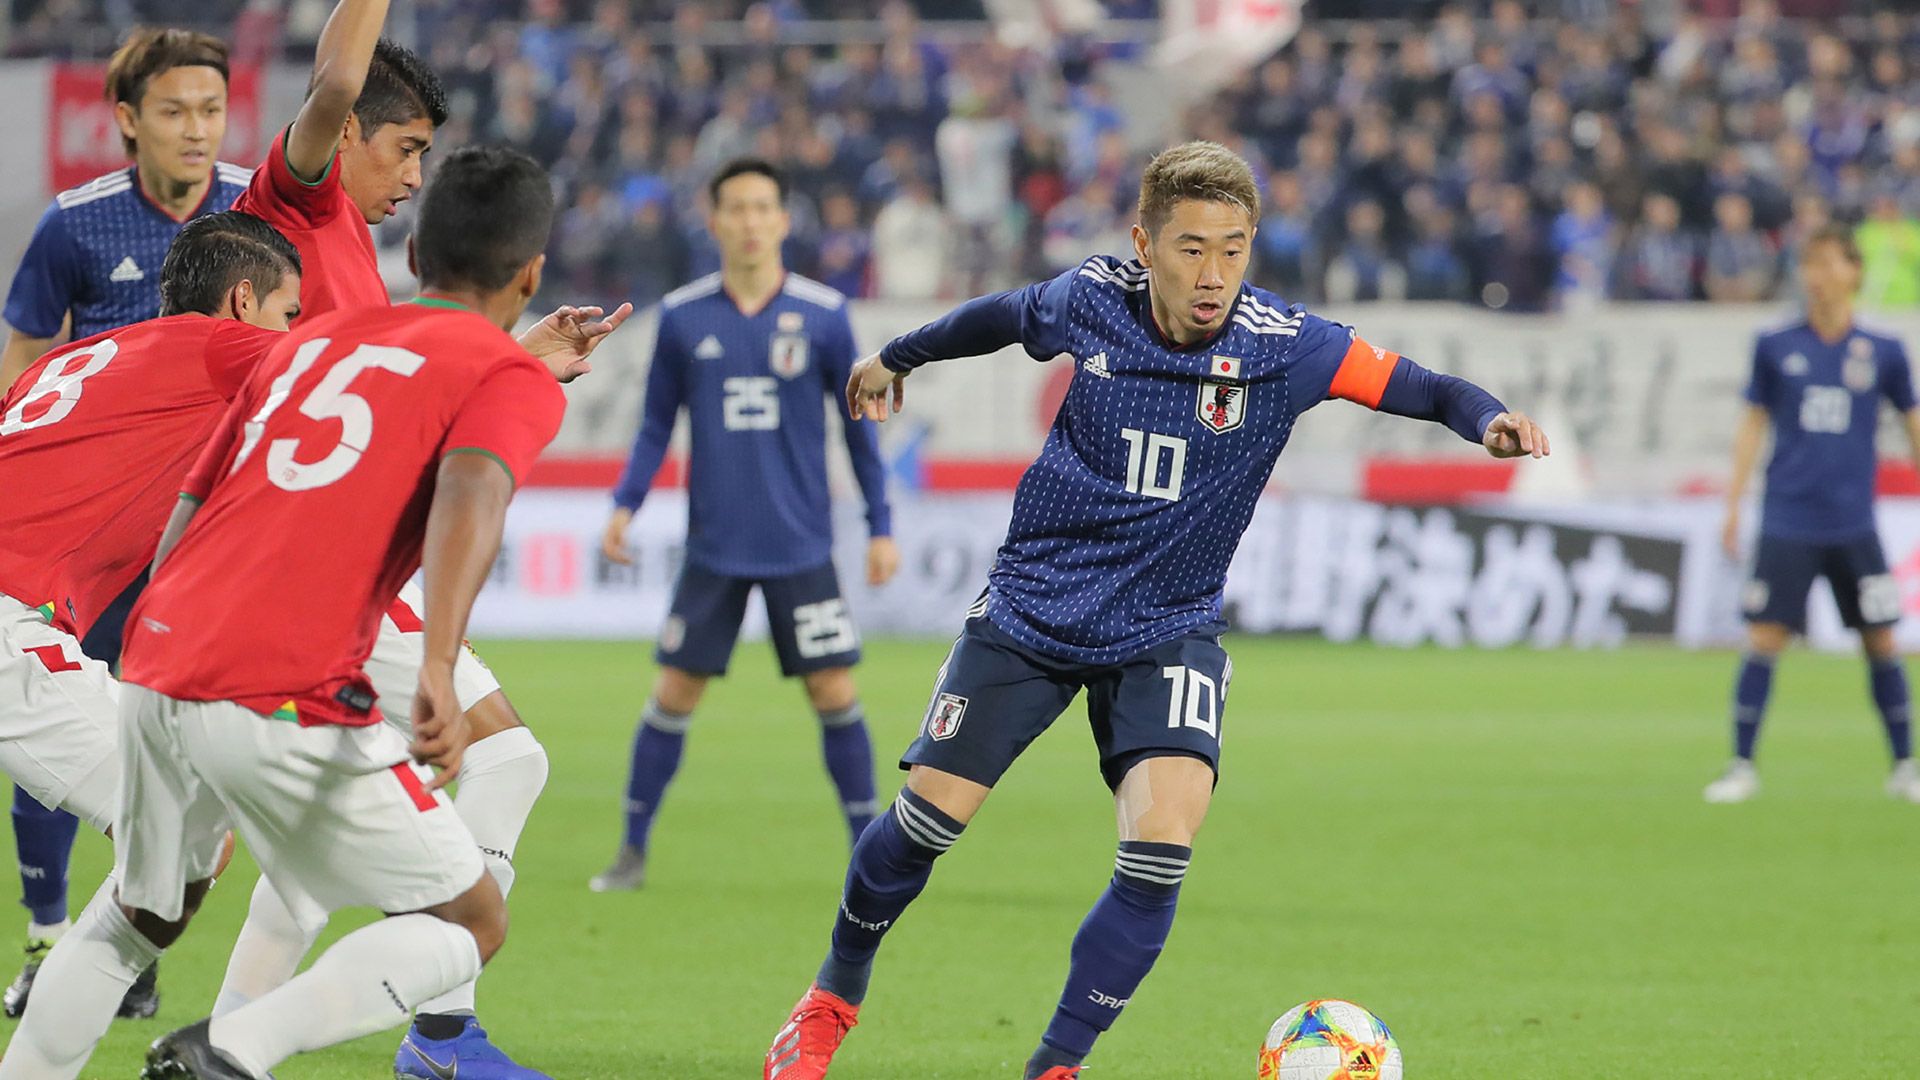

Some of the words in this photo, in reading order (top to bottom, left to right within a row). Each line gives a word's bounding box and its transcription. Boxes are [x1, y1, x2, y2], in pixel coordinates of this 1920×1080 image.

[0, 338, 119, 436] 8
[231, 337, 426, 492] 15
[723, 377, 780, 431] 25
[1121, 428, 1187, 501] 10
[794, 600, 858, 658] 25
[1162, 665, 1217, 739] 10
